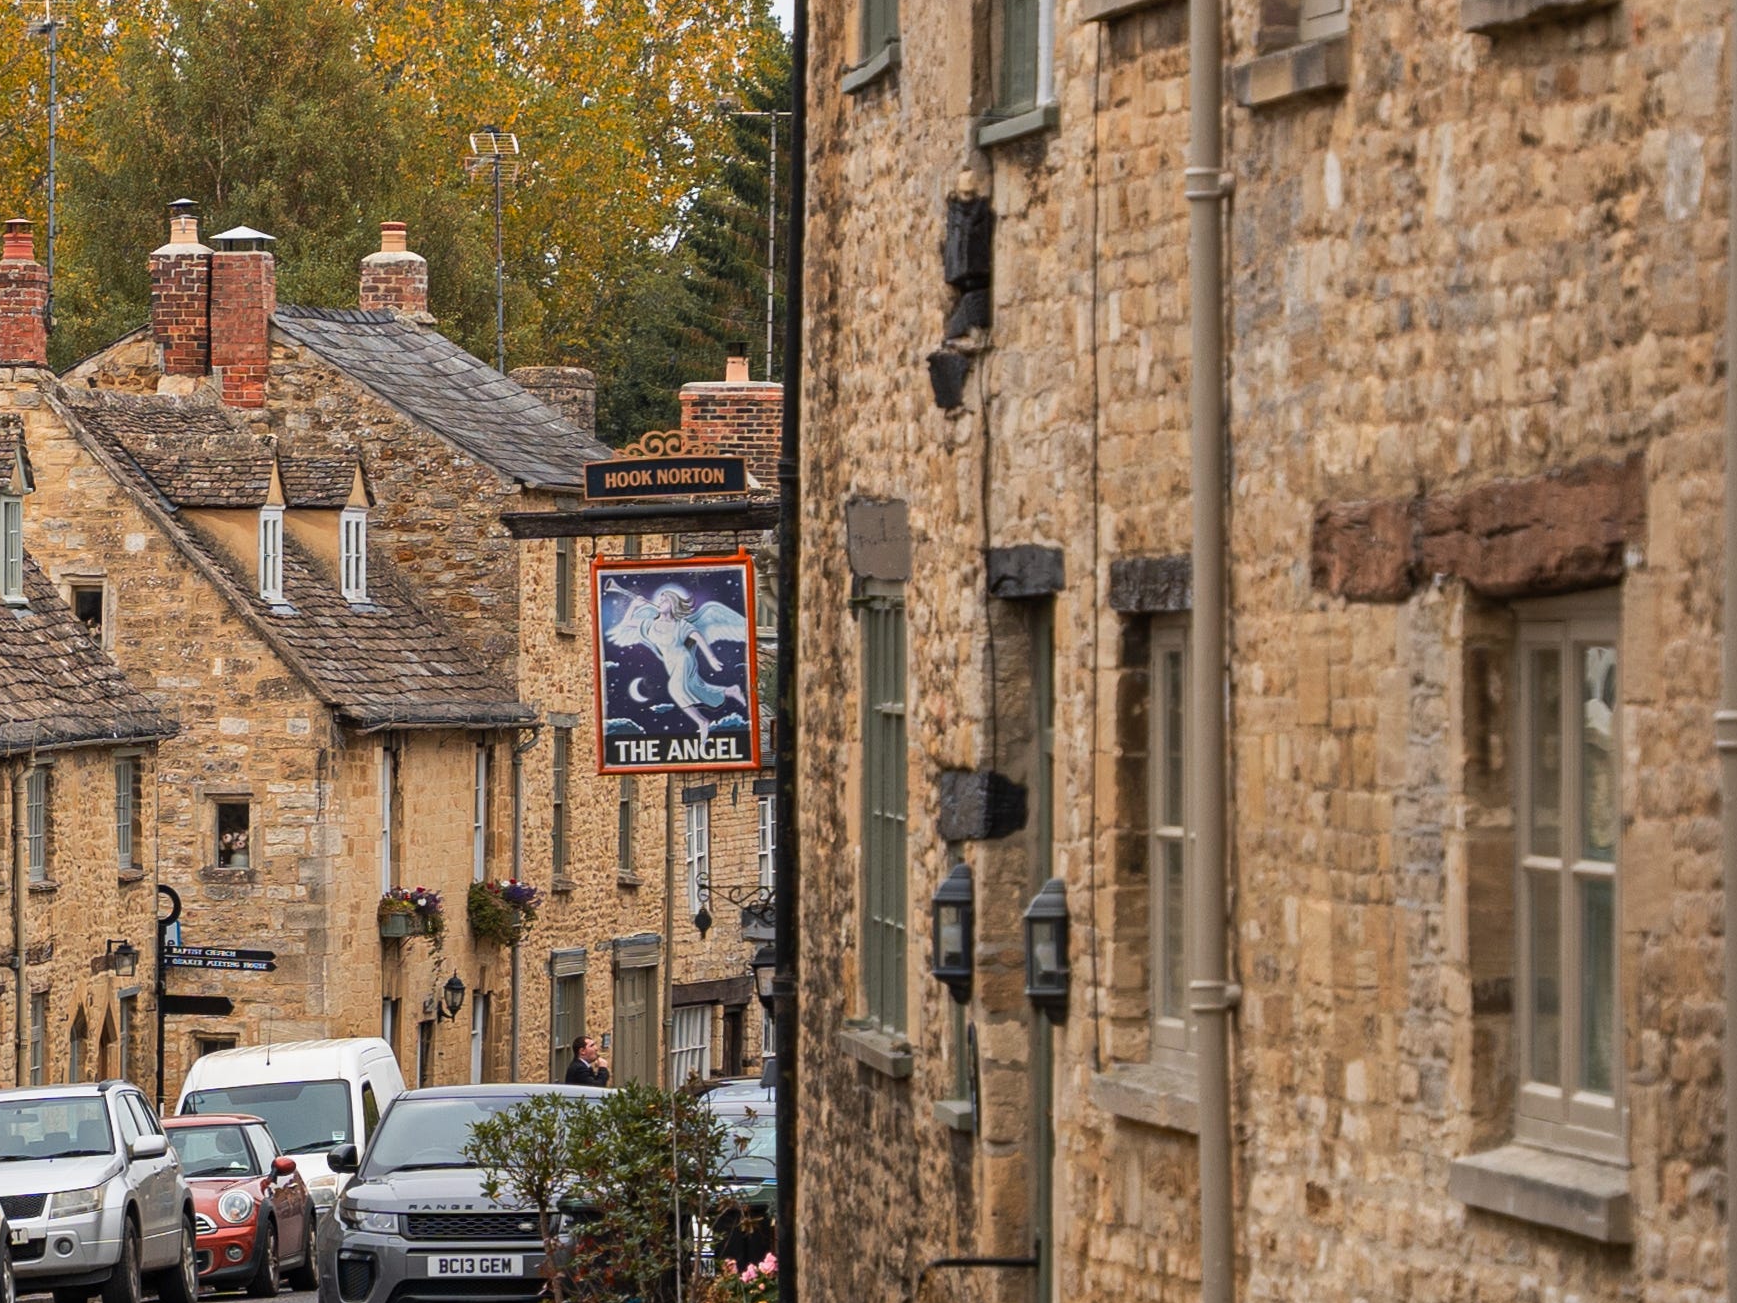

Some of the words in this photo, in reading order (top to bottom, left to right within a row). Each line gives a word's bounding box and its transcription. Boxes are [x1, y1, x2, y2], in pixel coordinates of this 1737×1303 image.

[605, 469, 653, 489] HOOK
[657, 467, 725, 485] NORTON
[614, 739, 661, 762] THE
[666, 737, 743, 760] ANGEL
[172, 947, 203, 955] BAPTIST
[204, 949, 236, 957] CHURCH
[172, 958, 203, 966] QUAKER
[206, 960, 240, 968] MEETING
[438, 1258, 475, 1274] BC13
[479, 1258, 512, 1273] GEM
